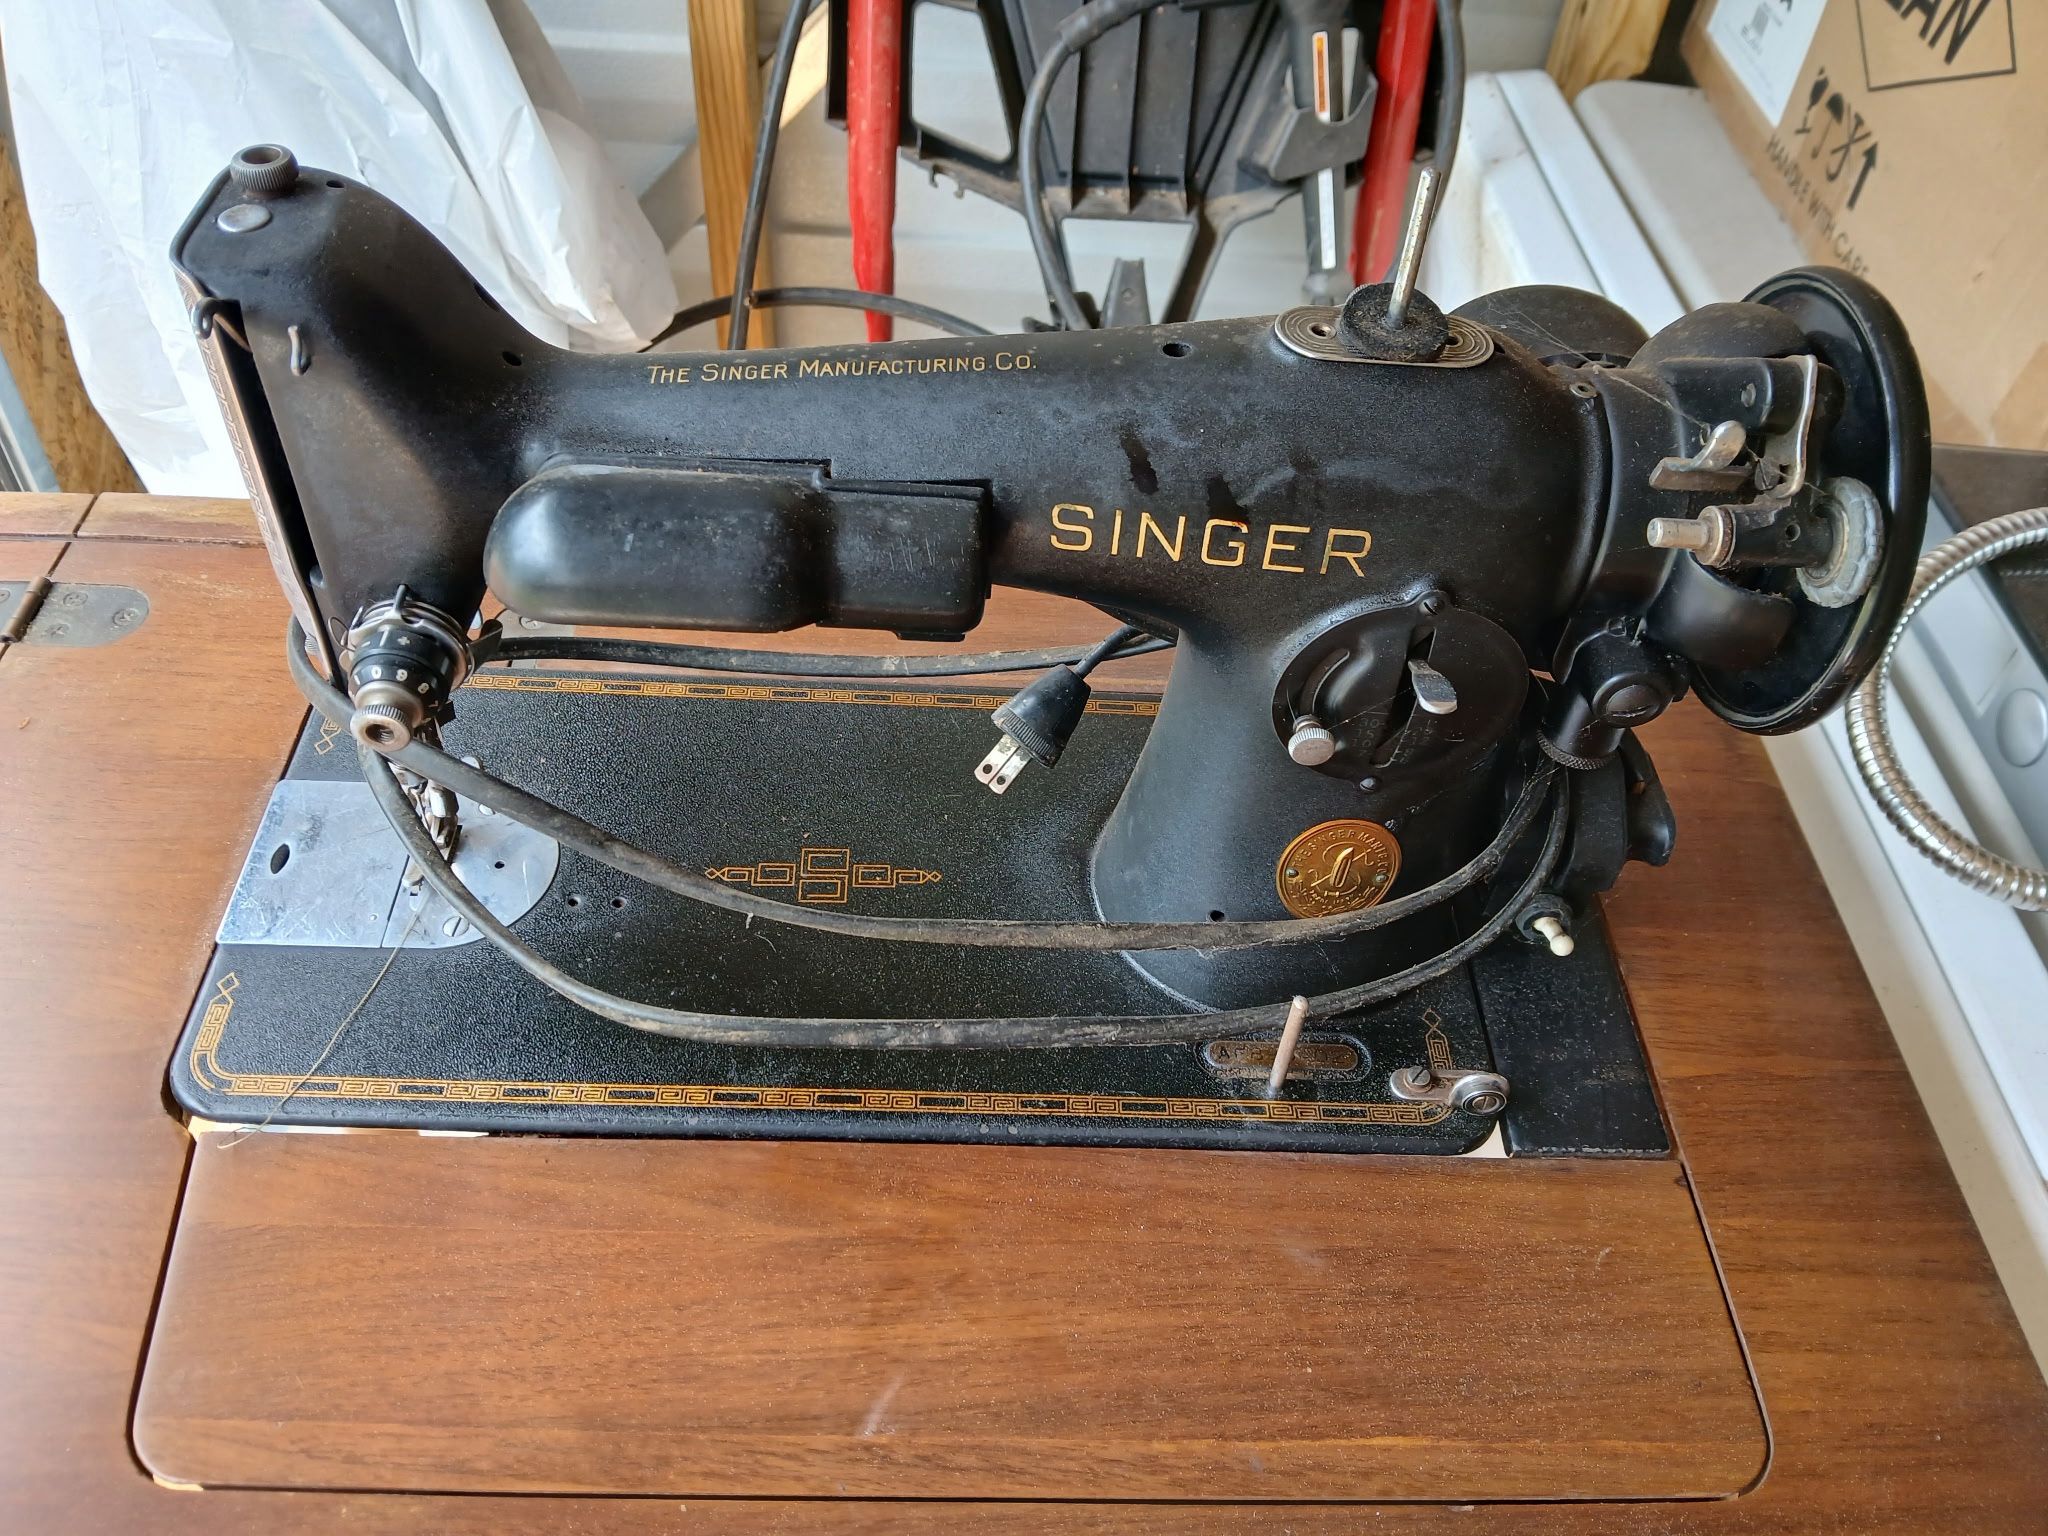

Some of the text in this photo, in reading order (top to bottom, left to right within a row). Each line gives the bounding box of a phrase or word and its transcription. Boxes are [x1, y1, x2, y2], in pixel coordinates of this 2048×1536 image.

[647, 351, 1037, 384] THE SINGER MANUFACTURING CO.
[1050, 503, 1373, 578] SINGER
